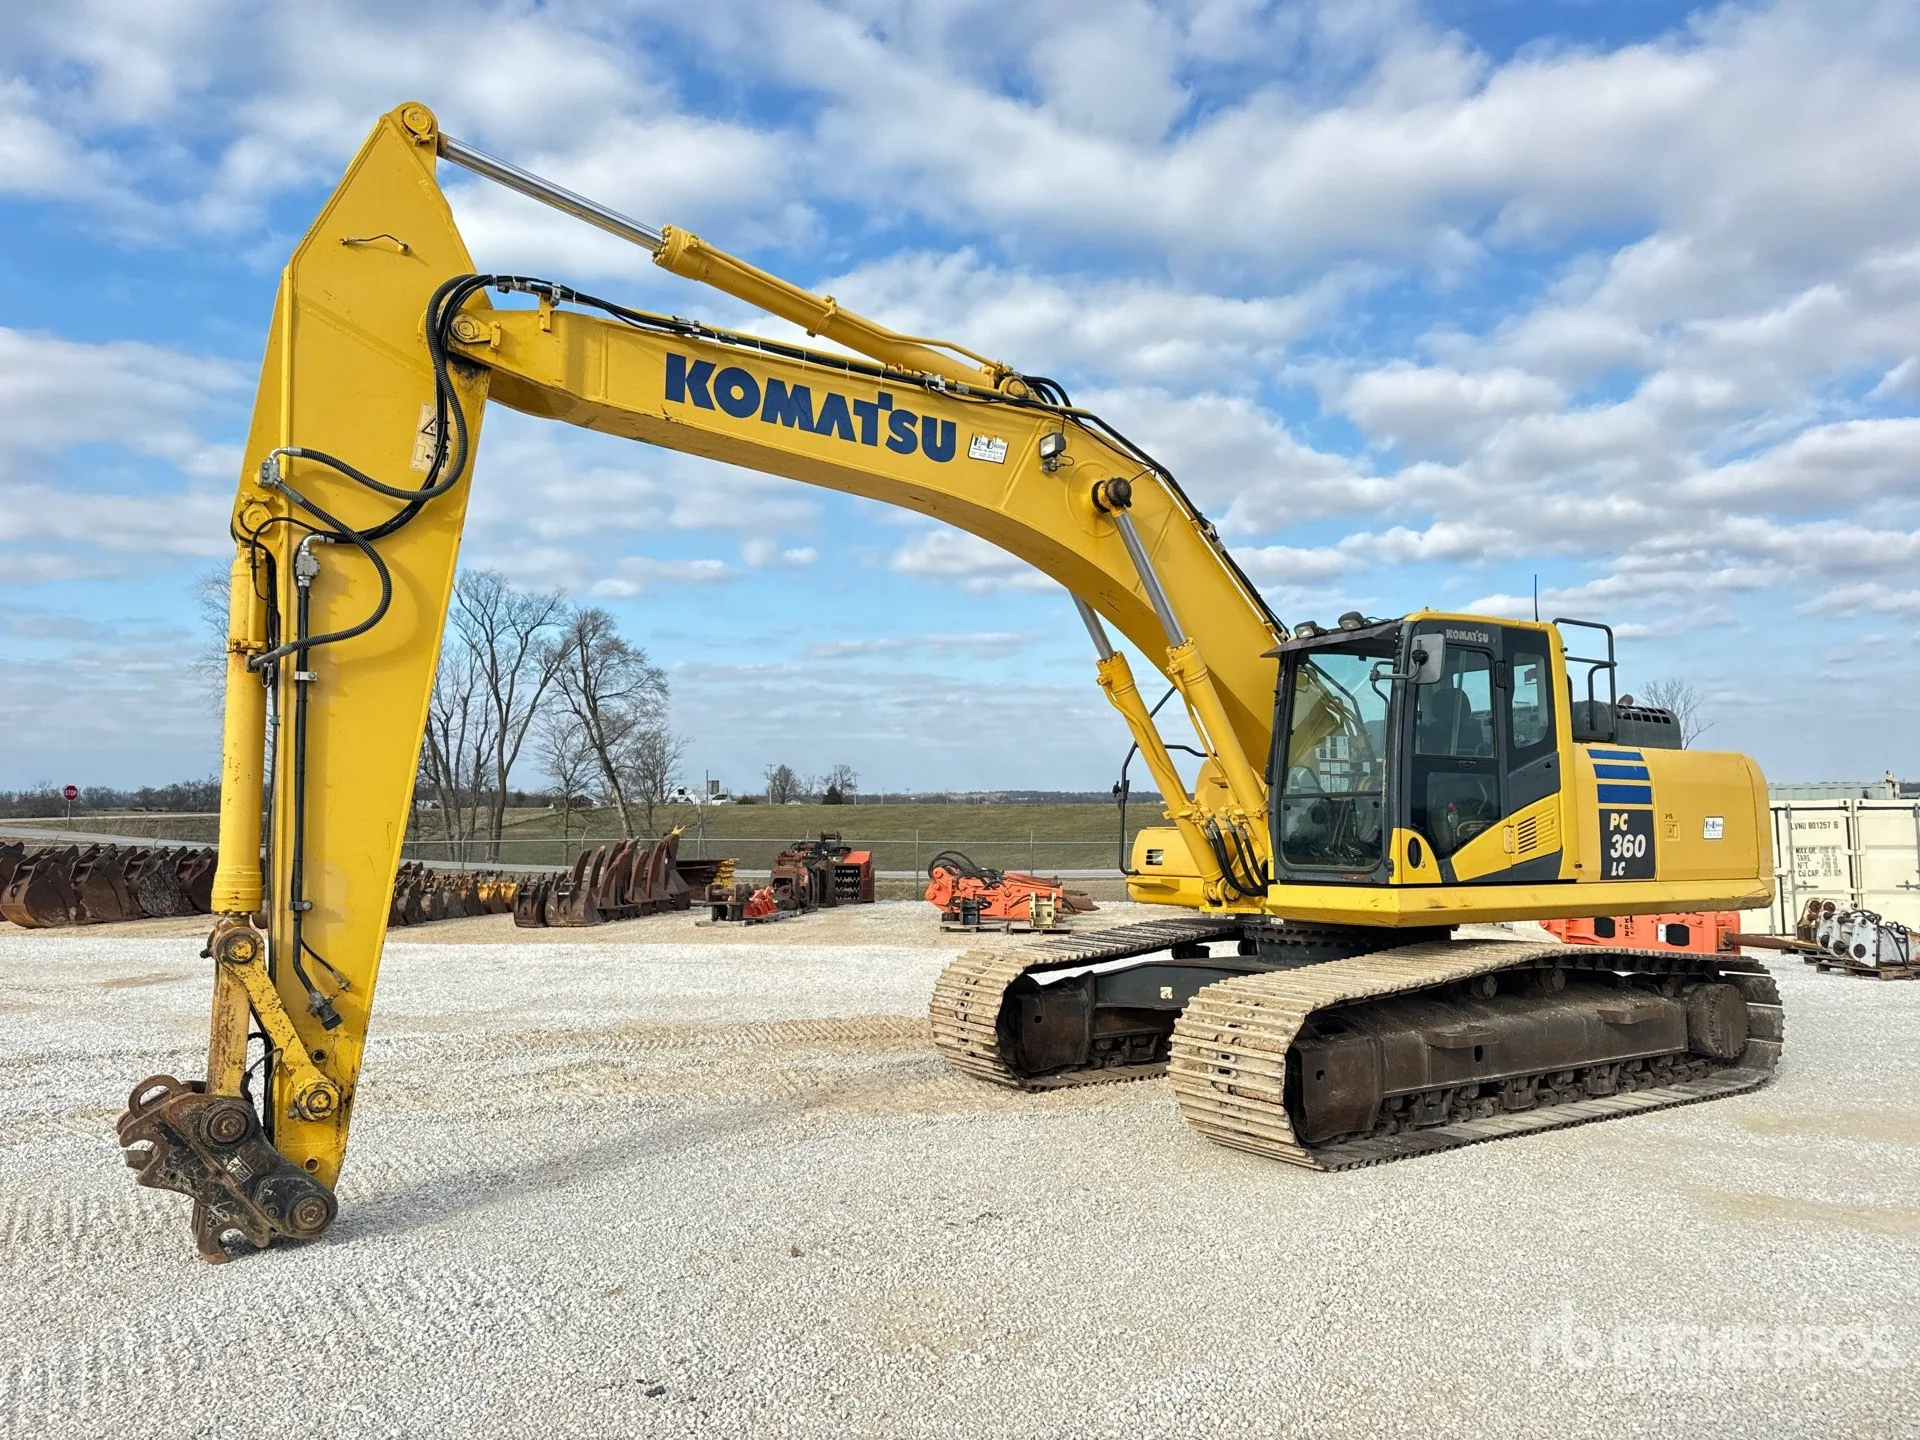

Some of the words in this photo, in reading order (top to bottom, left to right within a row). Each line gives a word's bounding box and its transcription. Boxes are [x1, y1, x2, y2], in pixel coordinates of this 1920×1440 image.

[665, 352, 956, 463] KOMATSU
[1445, 629, 1489, 643] KOMATSU
[65, 789, 77, 797] STOP
[1609, 813, 1629, 831] PC
[1610, 834, 1646, 858] 360
[1611, 861, 1626, 876] LC
